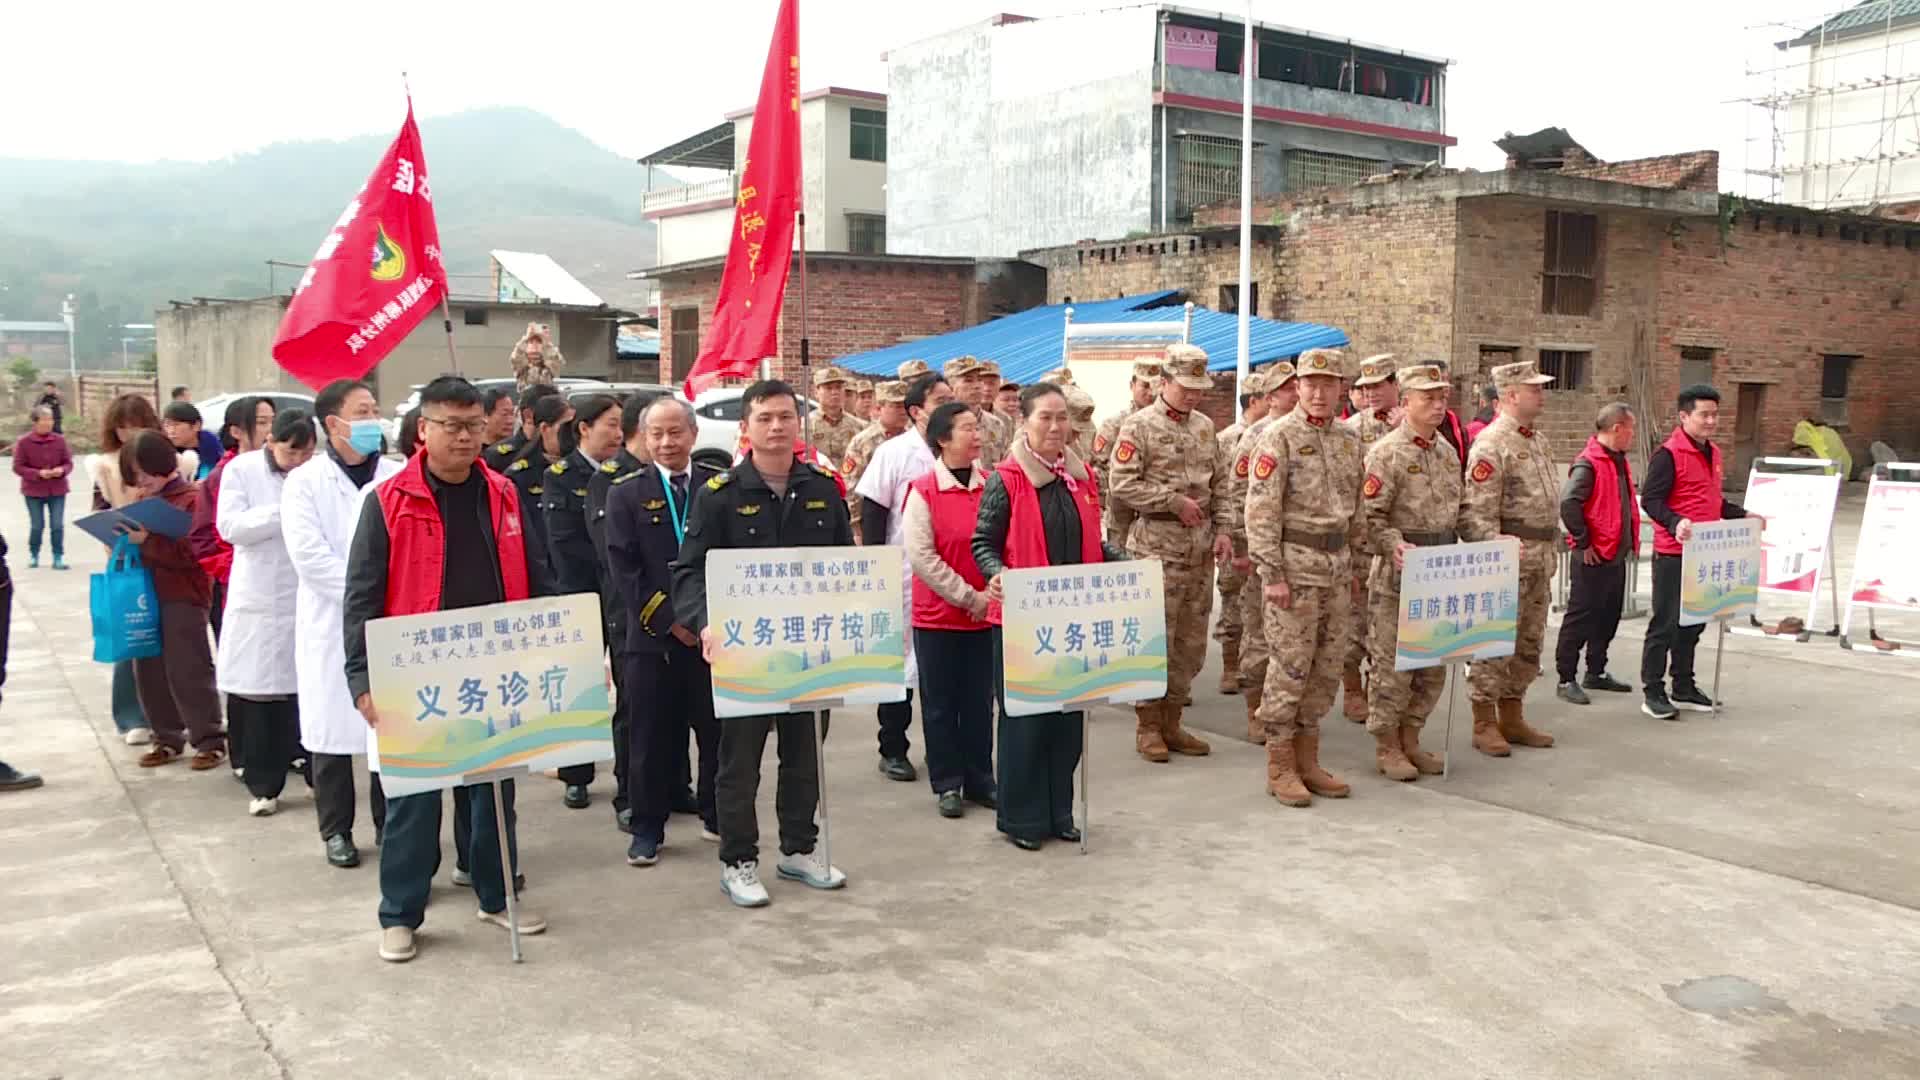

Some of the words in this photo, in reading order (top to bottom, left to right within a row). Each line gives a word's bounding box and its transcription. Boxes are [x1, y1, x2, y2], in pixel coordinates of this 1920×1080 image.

[1408, 588, 1512, 620] 国防教育宣传
[723, 610, 891, 648] 义务理疗按摩
[1034, 616, 1141, 656] 义务理发
[416, 665, 569, 722] 义务诊疗
